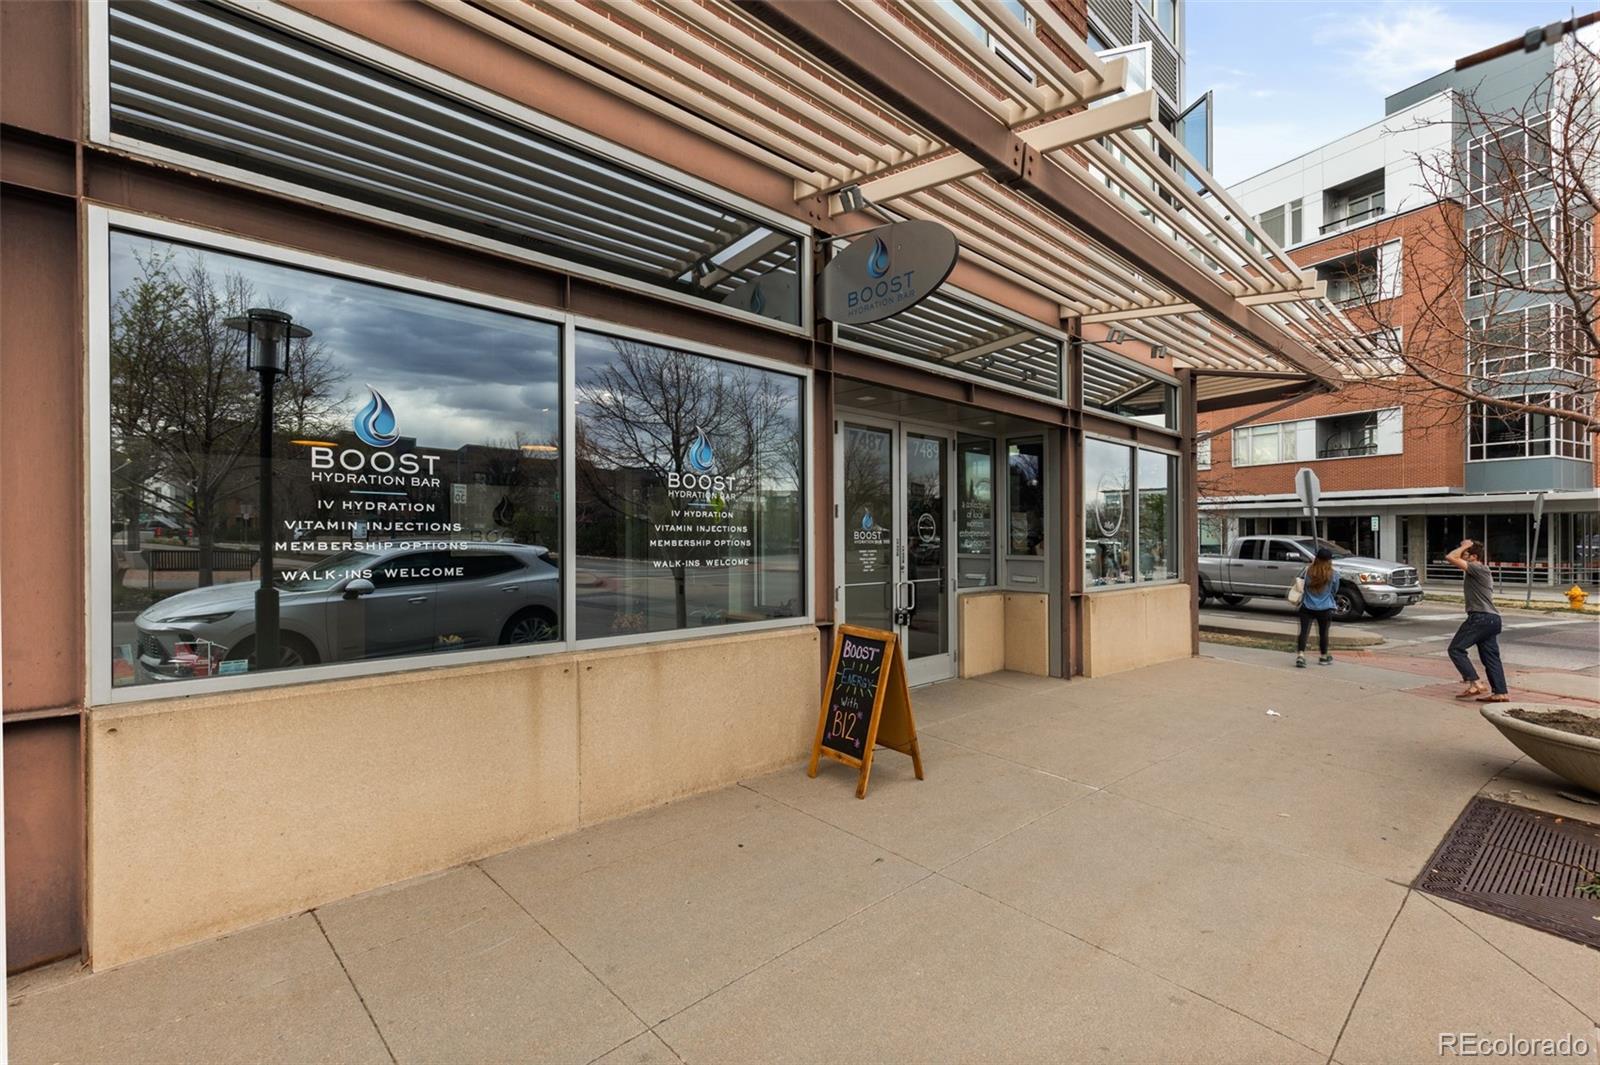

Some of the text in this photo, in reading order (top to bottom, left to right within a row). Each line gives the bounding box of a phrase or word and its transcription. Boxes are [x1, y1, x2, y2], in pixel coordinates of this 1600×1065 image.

[848, 271, 914, 307] BOOST
[913, 441, 939, 459] 7489
[311, 446, 440, 475] BOOST
[312, 471, 440, 488] HYDRATION BAR
[668, 472, 736, 491] BOOST
[668, 490, 718, 500] HYDRATION
[318, 500, 435, 512] IV HYDRATION
[284, 520, 462, 532] VITAMIN INJECTIONS
[654, 524, 748, 533] VITAMIN INJECTIONS
[853, 531, 882, 540] BOOST
[275, 541, 468, 551] MEMBERSHIP OPTIONS
[650, 539, 752, 547] MEMBERSHIP OPTIONS
[653, 558, 750, 568] WALK-INS WELCOME
[281, 567, 464, 581] WALK-INS WELCOME
[843, 639, 880, 662] BOOST
[832, 710, 856, 741] B12
